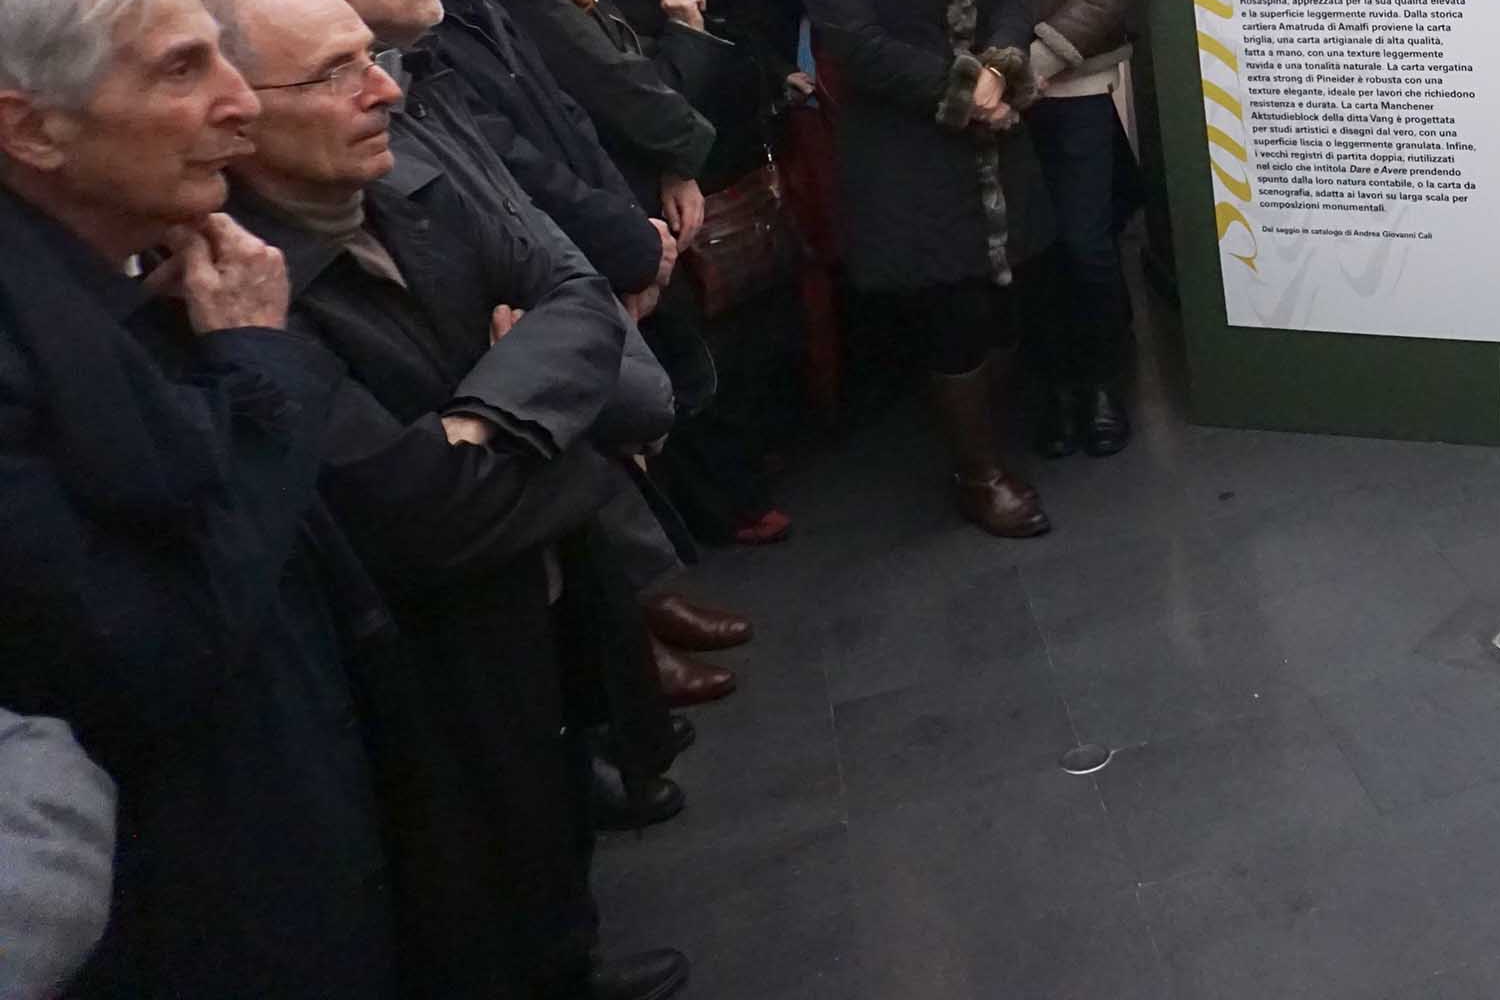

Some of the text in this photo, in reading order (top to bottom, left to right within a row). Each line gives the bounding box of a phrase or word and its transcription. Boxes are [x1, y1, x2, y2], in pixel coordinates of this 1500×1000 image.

[1242, 23, 1277, 31] cartiera
[1279, 23, 1325, 31] Amatruda
[1338, 23, 1369, 31] Amalfi
[1372, 23, 1413, 32] proviene
[1323, 36, 1373, 46] artigianale
[1387, 36, 1405, 44] alta
[1273, 76, 1303, 84] strong
[1316, 74, 1355, 83] Pineider
[1366, 76, 1402, 84] robusta
[1251, 112, 1319, 121] Aktstudieblock
[1322, 113, 1344, 121] della
[1347, 114, 1368, 122] ditta
[1370, 114, 1394, 125] Vang
[1405, 117, 1455, 125] progettata
[1256, 162, 1270, 170] nel
[1272, 162, 1293, 171] ciclo
[1296, 163, 1311, 172] che
[1314, 164, 1346, 173] intitola
[1349, 165, 1371, 174] Dare
[1380, 166, 1408, 175] Avere
[1410, 168, 1461, 176] prendendo
[1258, 176, 1289, 184] spunto
[1291, 176, 1313, 184] dalla
[1316, 176, 1334, 185] loro
[1315, 190, 1344, 198] adatta
[1358, 191, 1383, 199] lavori
[1400, 192, 1423, 202] larga
[1425, 193, 1449, 201] scala
